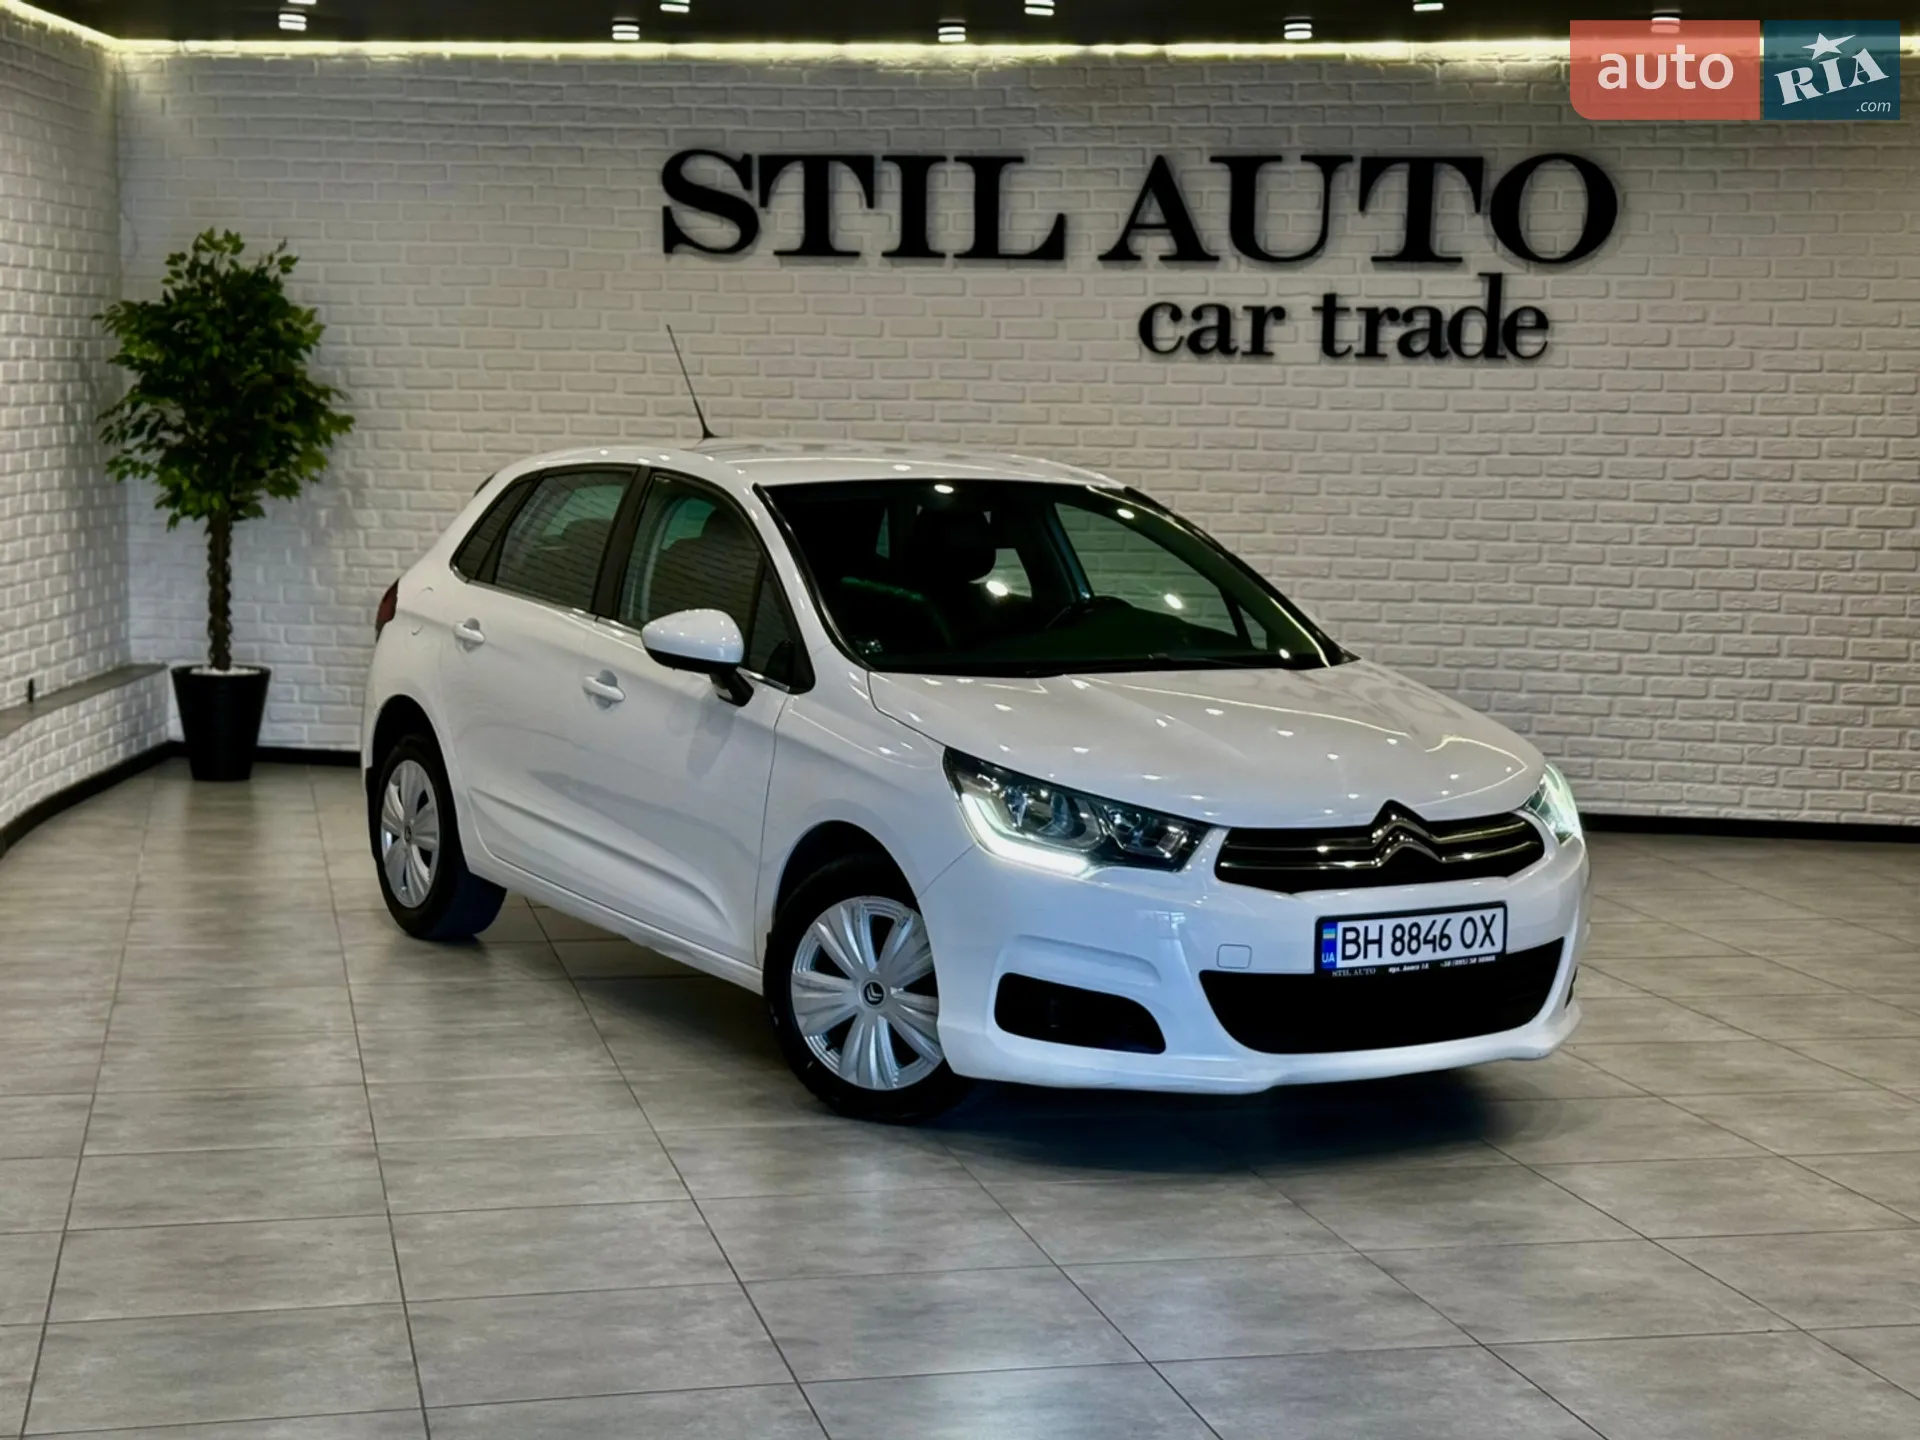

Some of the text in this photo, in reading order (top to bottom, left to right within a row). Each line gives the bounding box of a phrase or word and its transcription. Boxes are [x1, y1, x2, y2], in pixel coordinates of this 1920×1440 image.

[661, 148, 1619, 265] STIL AUTO
[1138, 272, 1549, 361] car trade
[1322, 952, 1335, 963] UA
[1341, 913, 1497, 961] BH 8846 OX
